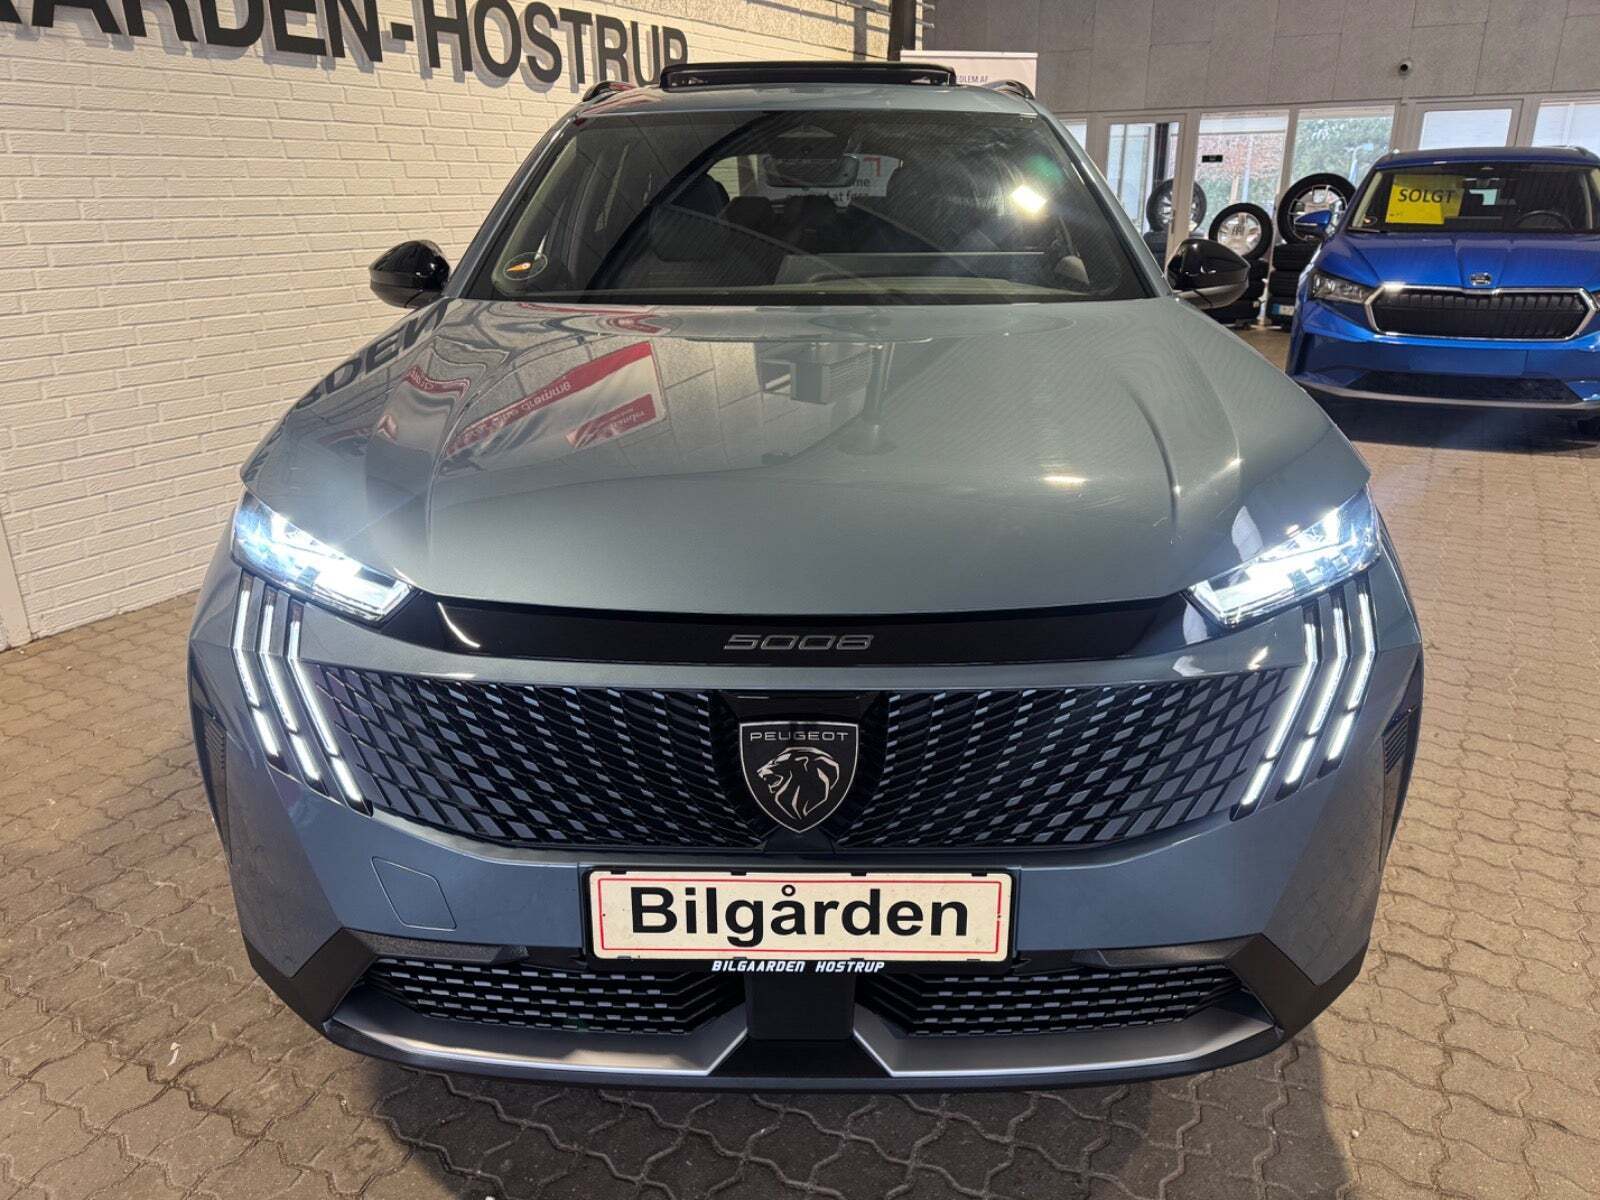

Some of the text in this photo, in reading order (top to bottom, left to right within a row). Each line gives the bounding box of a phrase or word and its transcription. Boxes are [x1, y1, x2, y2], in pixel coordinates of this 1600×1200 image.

[0, 0, 688, 87] EN-HOSTRUP
[1397, 188, 1456, 204] SOLGT
[723, 634, 875, 650] 5008
[750, 731, 849, 742] PEUGEOT
[630, 884, 969, 948] Bilgården
[711, 960, 886, 974] BILGAARDEN HOSTRUP
